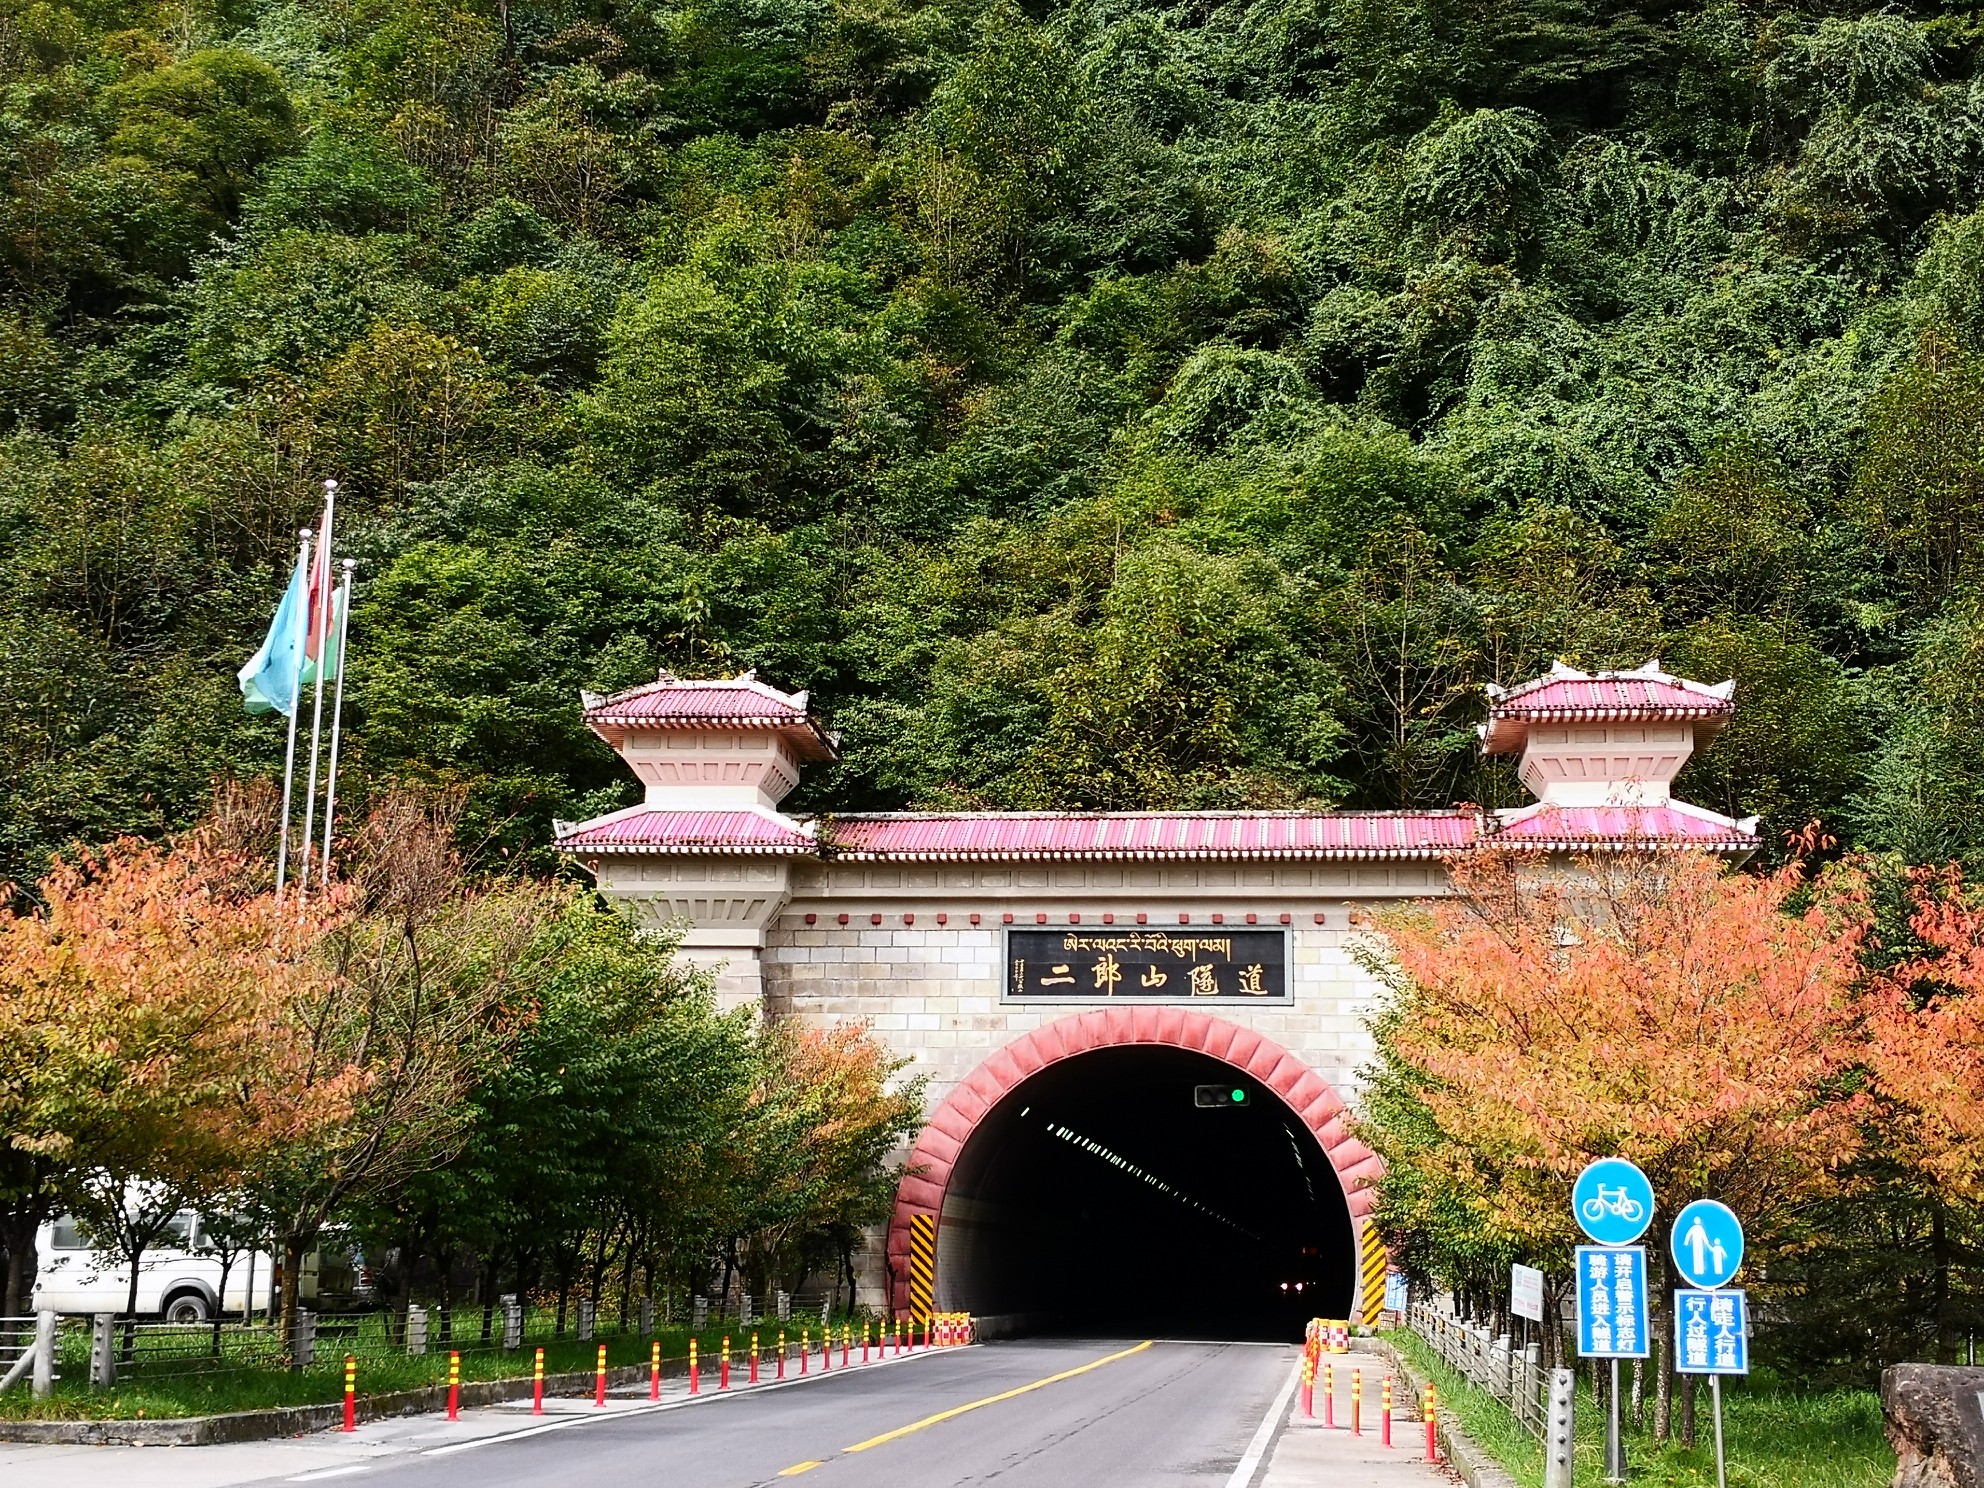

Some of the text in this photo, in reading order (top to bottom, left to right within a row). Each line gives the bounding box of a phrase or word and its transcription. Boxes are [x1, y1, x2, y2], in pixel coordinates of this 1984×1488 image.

[1041, 953, 1268, 996] 二郎山隧道
[1588, 1254, 1612, 1352] 骑游人员进入隧道
[1614, 1253, 1636, 1352] 请开启警示标志灯
[1685, 1297, 1708, 1366] 行人过隧道
[1712, 1297, 1737, 1367] 请走人行道
